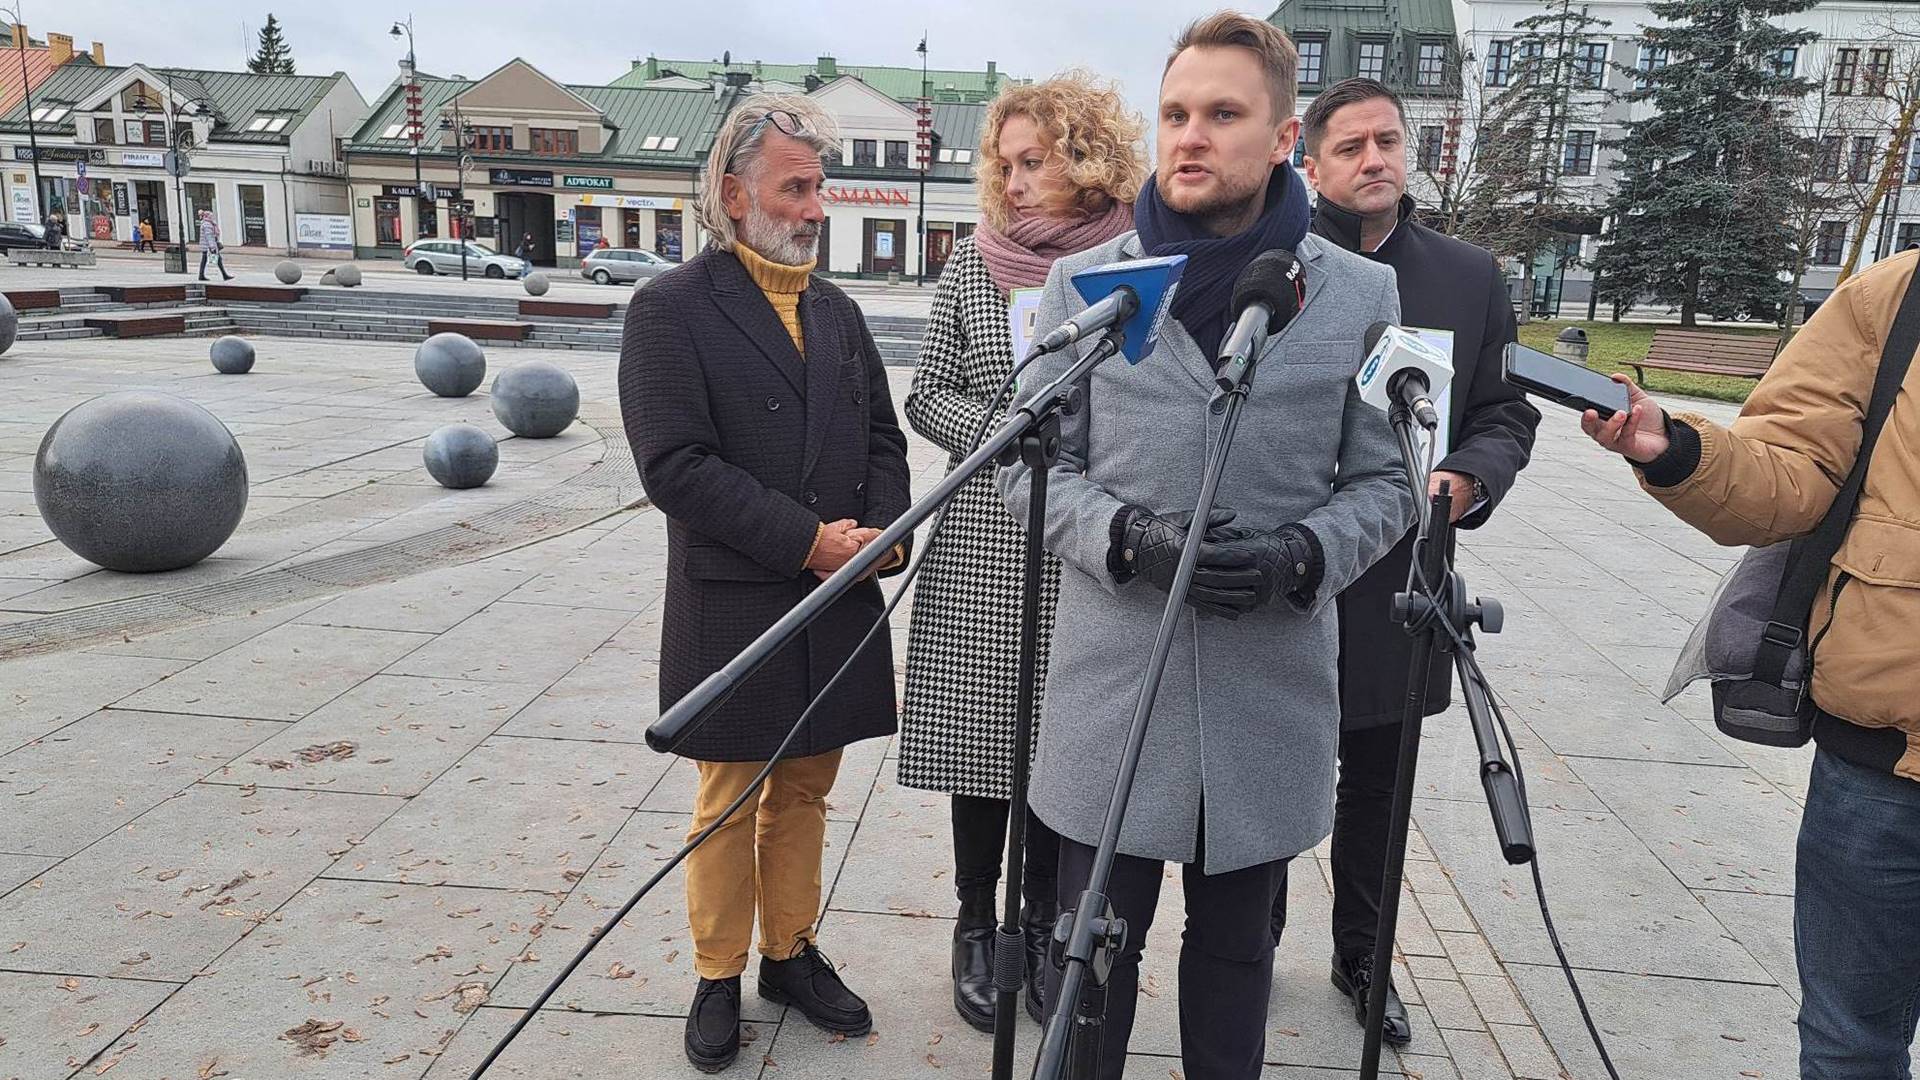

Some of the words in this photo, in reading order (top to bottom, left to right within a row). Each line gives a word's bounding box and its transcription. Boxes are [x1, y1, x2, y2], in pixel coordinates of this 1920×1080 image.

[566, 177, 611, 187] ADWOKAT
[818, 185, 909, 207] SMANN
[626, 198, 655, 207] vectra
